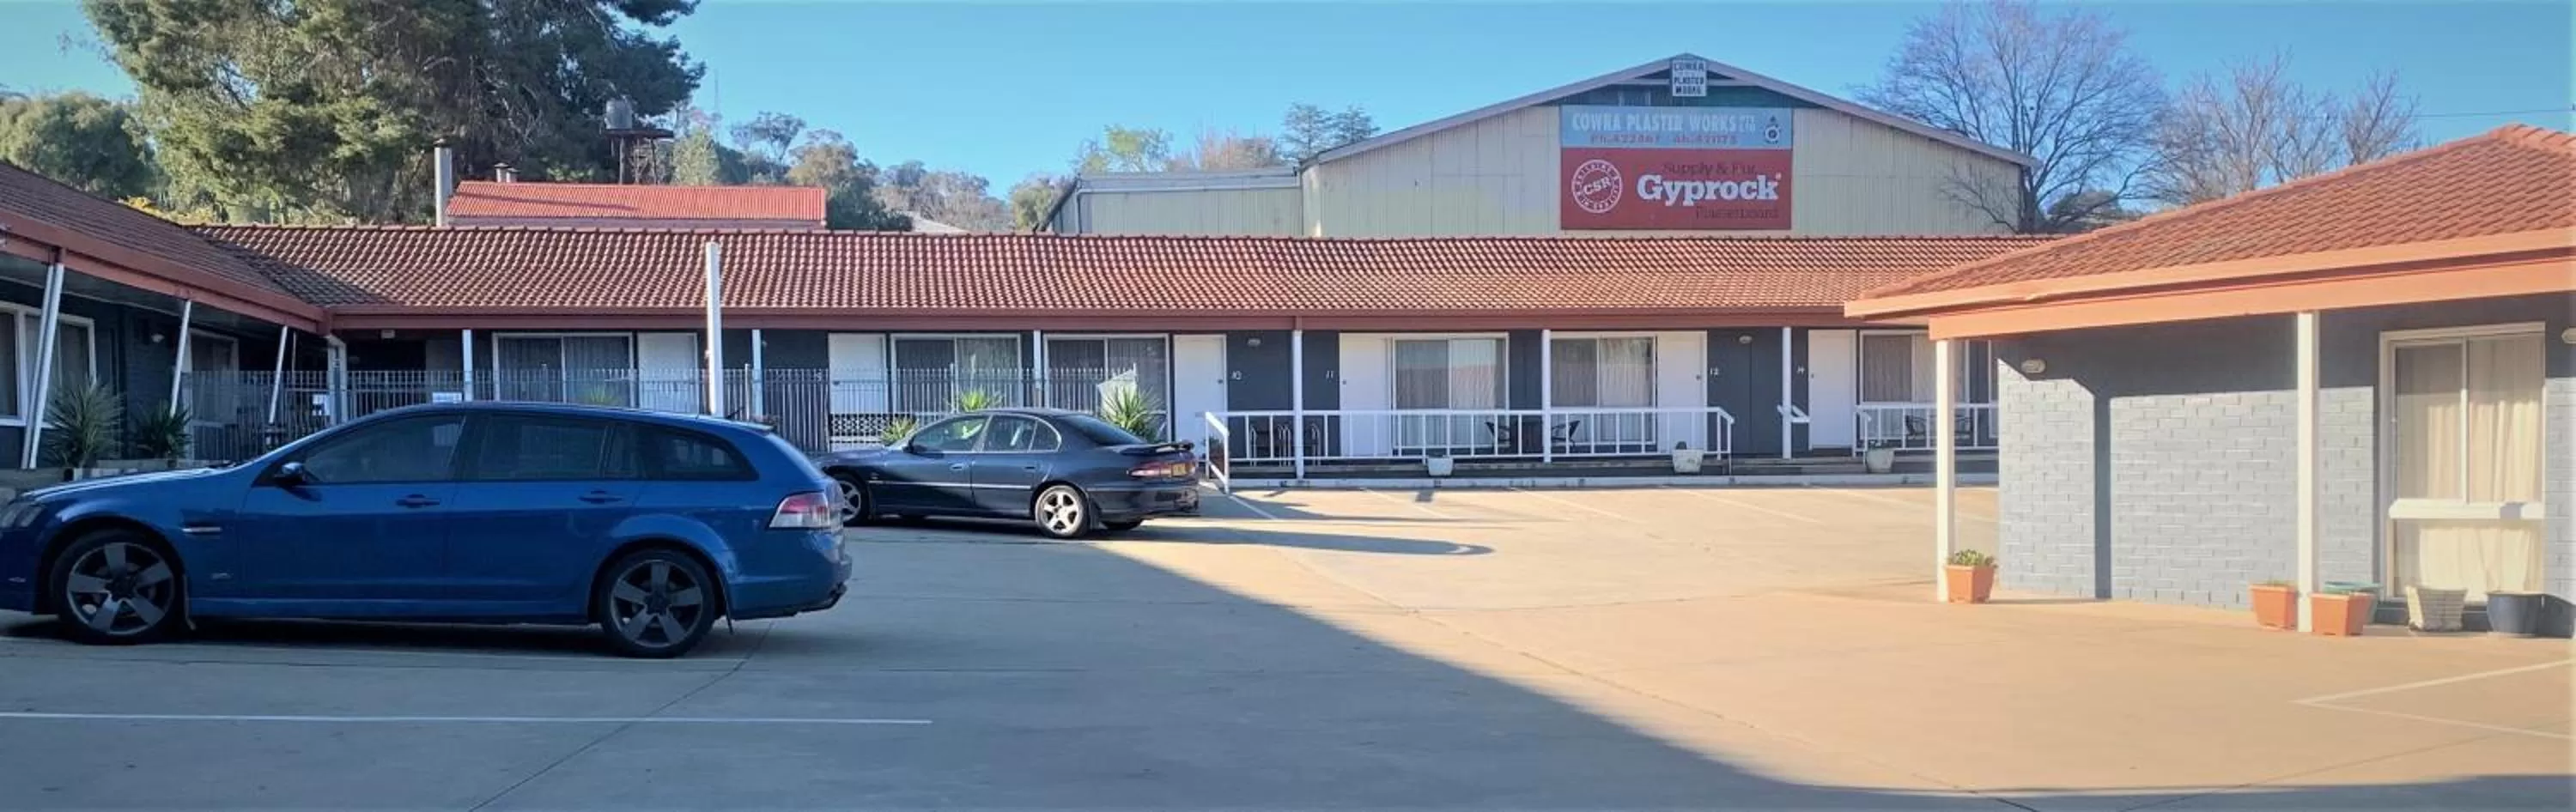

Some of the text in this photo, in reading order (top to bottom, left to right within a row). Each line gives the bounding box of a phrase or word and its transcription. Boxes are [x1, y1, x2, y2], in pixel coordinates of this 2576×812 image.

[1572, 112, 1736, 132] COWRA PLASTER WORKS
[1662, 161, 1713, 176] Supply
[1716, 161, 1728, 174] &
[1583, 176, 1612, 195] CSR
[1637, 173, 1778, 207] Gyprock
